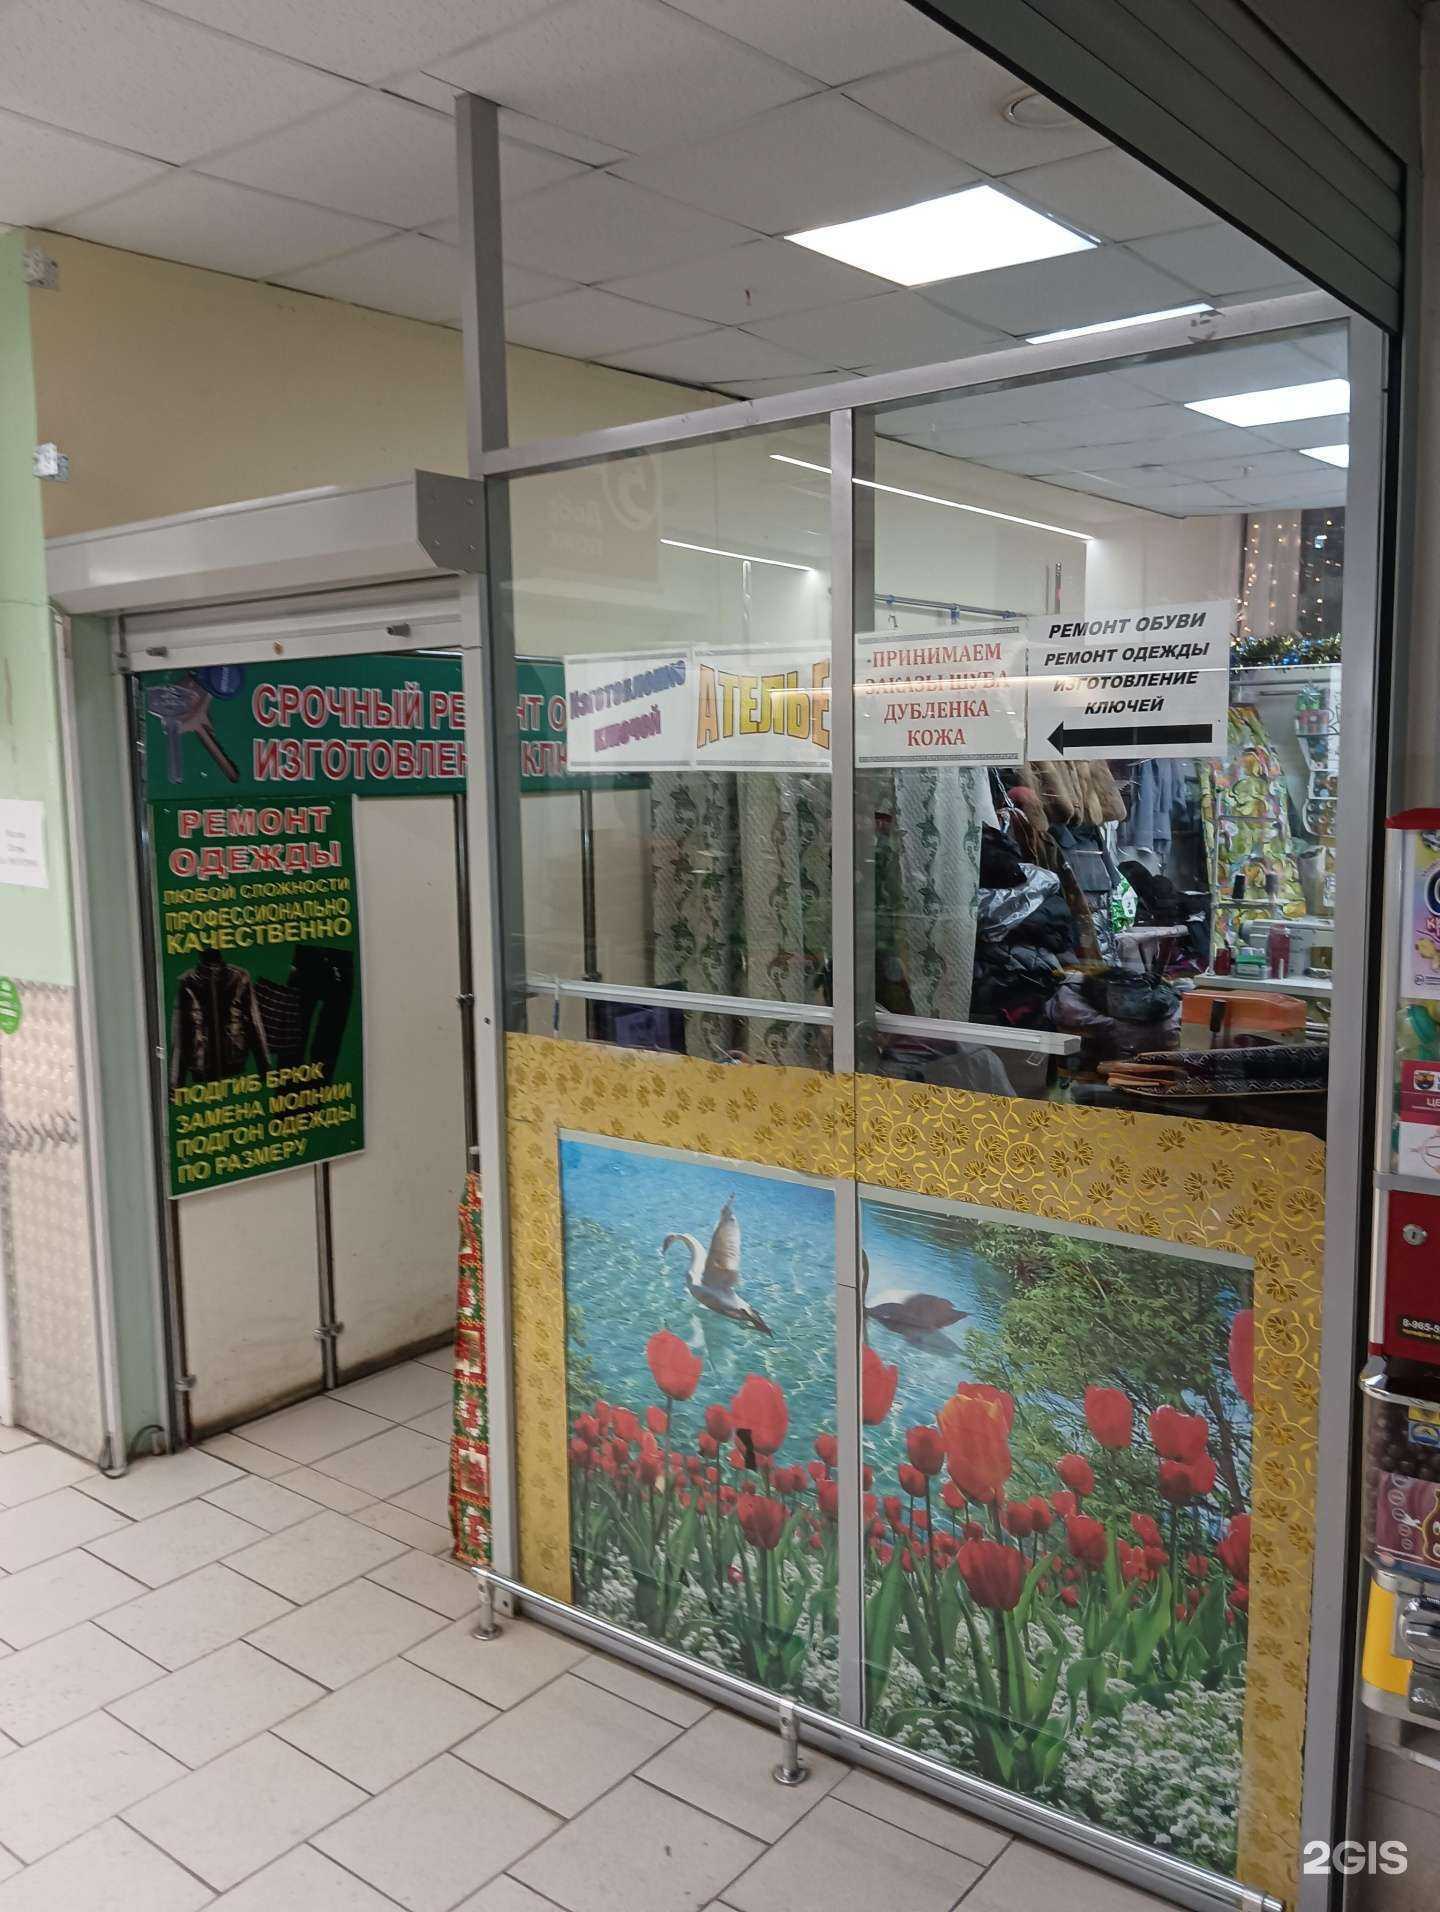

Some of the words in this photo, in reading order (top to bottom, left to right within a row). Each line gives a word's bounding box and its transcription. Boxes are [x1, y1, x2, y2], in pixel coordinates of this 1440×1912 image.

[1049, 617, 1127, 640] РЕМОНТ
[1135, 612, 1207, 633] ОБУВИ
[872, 641, 1002, 668] ПРИНИМАЕМ
[1044, 648, 1118, 667] РЕМОНТ
[1121, 641, 1211, 662] ОДЕЖДЫ
[1053, 670, 1200, 693] ИЗГОТОВЛЕНИЕ
[251, 681, 425, 730] СРОЧНЫЙ
[696, 658, 830, 750] АТЕЛЬЕ
[883, 699, 990, 724] ДУБЛЕНКА
[1084, 695, 1165, 716] КЛЮЧЕЙ
[907, 728, 967, 747] КОЖА
[178, 806, 332, 839] РЕМОНТ
[168, 840, 343, 881] ОДЕЖДЫ
[163, 884, 237, 905] ЛЮБОЙ
[239, 877, 350, 899] СЛОЖНОСТИ
[164, 897, 351, 931] ПРОФЕССИОНАЛЬНО
[166, 917, 353, 955] КАЧЕСТВЕННО
[173, 1073, 262, 1107] ПОДГИБ
[265, 1062, 325, 1089] БРЮК
[175, 1100, 266, 1135] ЗАМЕНА
[268, 1082, 352, 1114] МОЛНИИ
[176, 1122, 265, 1158] ПОДГОН
[267, 1103, 357, 1137] ОДЕЖДЫ
[177, 1160, 212, 1184] ПО
[215, 1138, 309, 1176] РАЗМЕРУ
